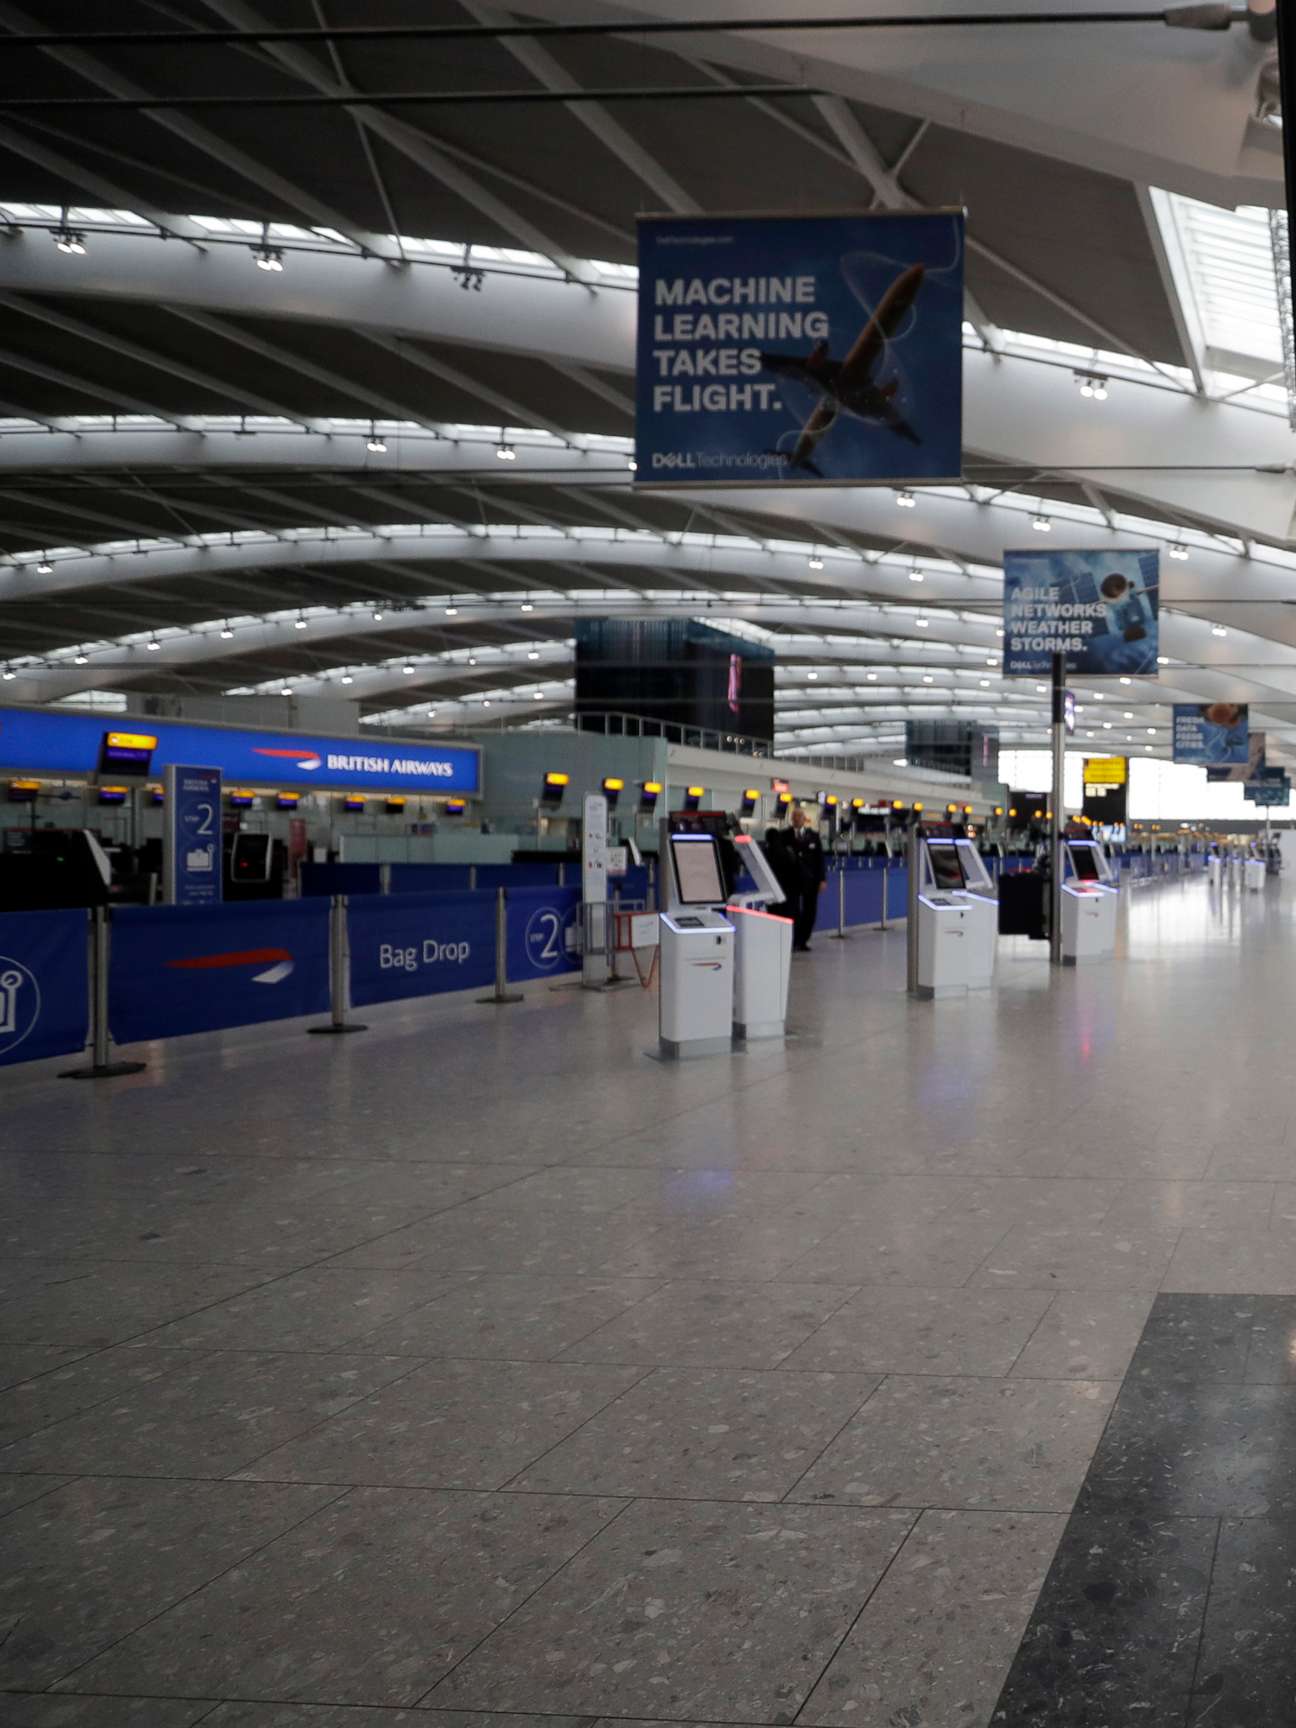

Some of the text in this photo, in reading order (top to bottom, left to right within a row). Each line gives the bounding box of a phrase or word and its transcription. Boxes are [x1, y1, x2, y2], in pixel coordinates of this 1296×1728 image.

[654, 276, 815, 306] MACHINE
[654, 311, 829, 341] LEARNING
[654, 348, 762, 377] TAKES
[653, 384, 783, 412] FLIGHT.
[652, 452, 788, 469] DELL Technologies
[1011, 587, 1059, 600] AGILE
[1010, 603, 1107, 618] NETWORKS
[1010, 620, 1092, 634] WEATHER
[1010, 638, 1087, 651] STORMS.
[327, 754, 453, 777] BRITISH AIRWAYS
[197, 804, 213, 834] 2
[540, 914, 558, 958] 2
[380, 940, 469, 970] Bag Drop
